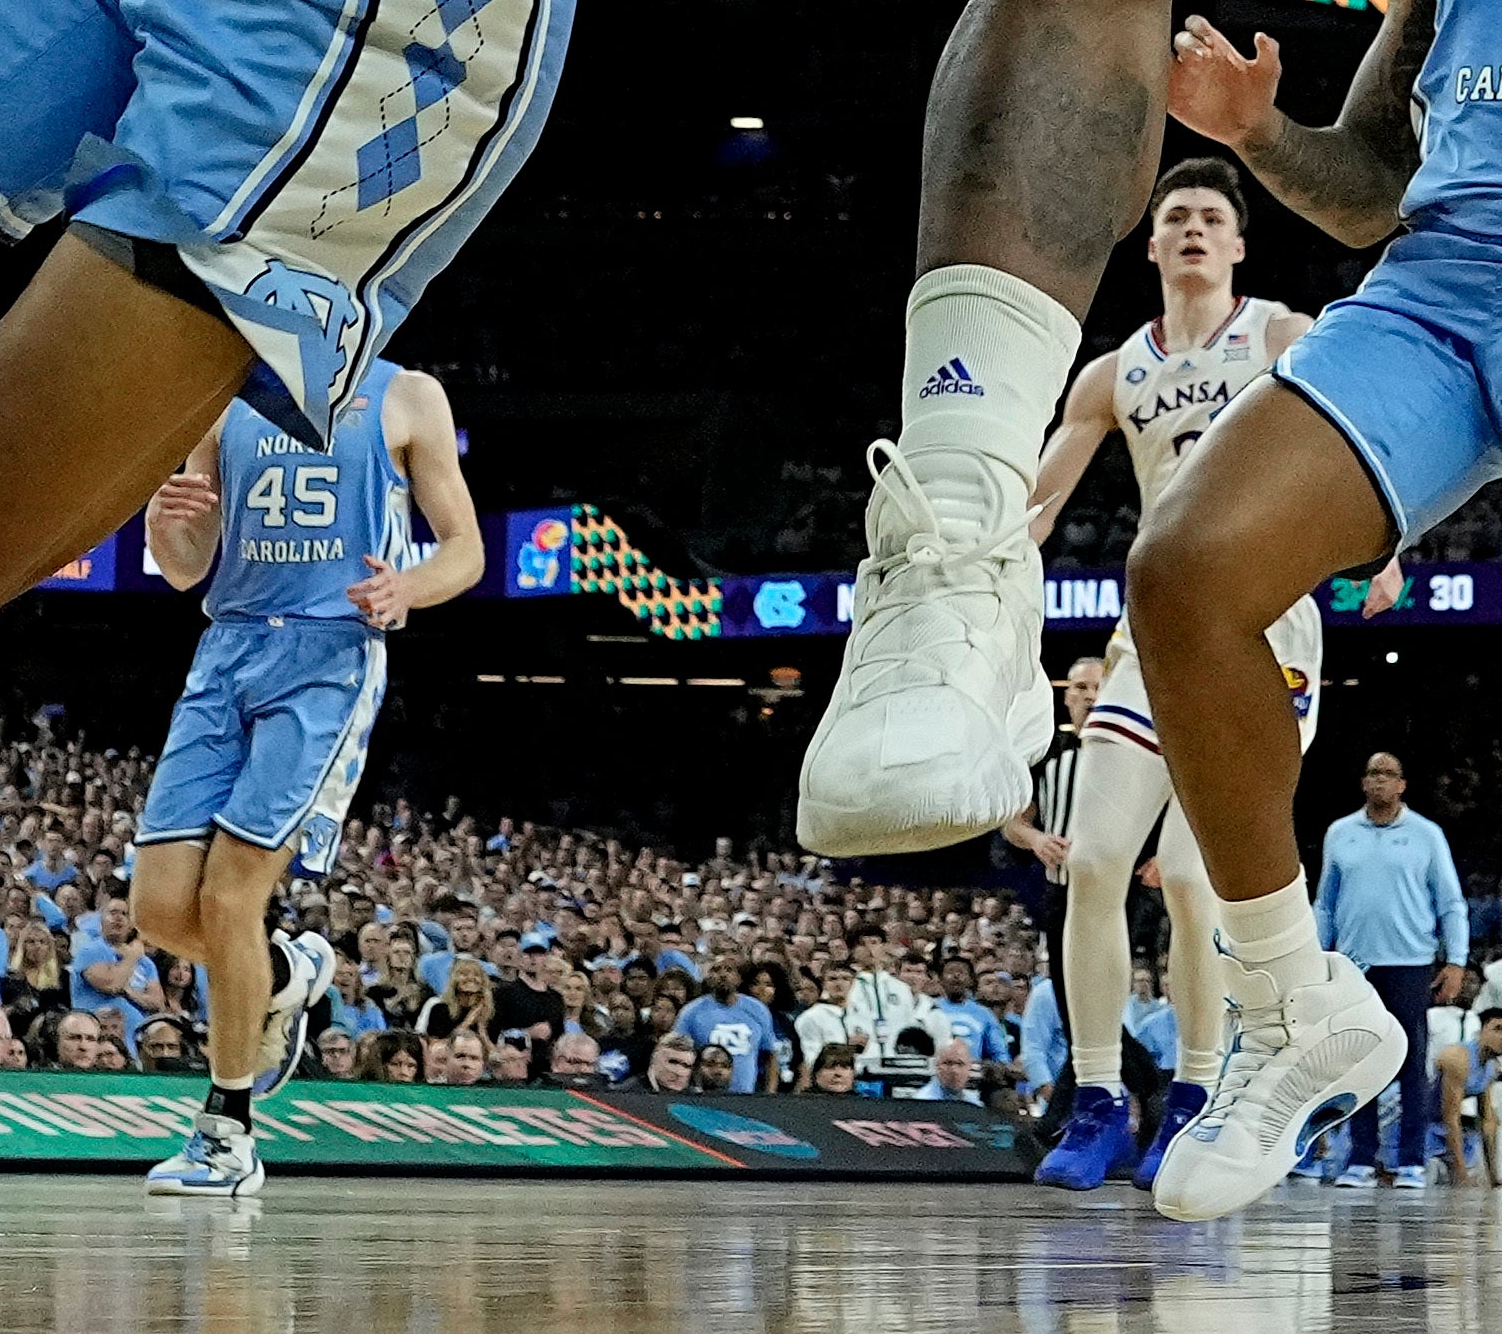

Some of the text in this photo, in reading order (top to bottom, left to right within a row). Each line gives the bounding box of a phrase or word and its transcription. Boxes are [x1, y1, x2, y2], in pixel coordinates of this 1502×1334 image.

[919, 377, 985, 399] adidas
[1127, 380, 1231, 435] KANSA
[246, 465, 339, 529] 45
[240, 537, 345, 564] CAROLINA
[1044, 579, 1122, 619] LINA
[1428, 574, 1474, 612] 30
